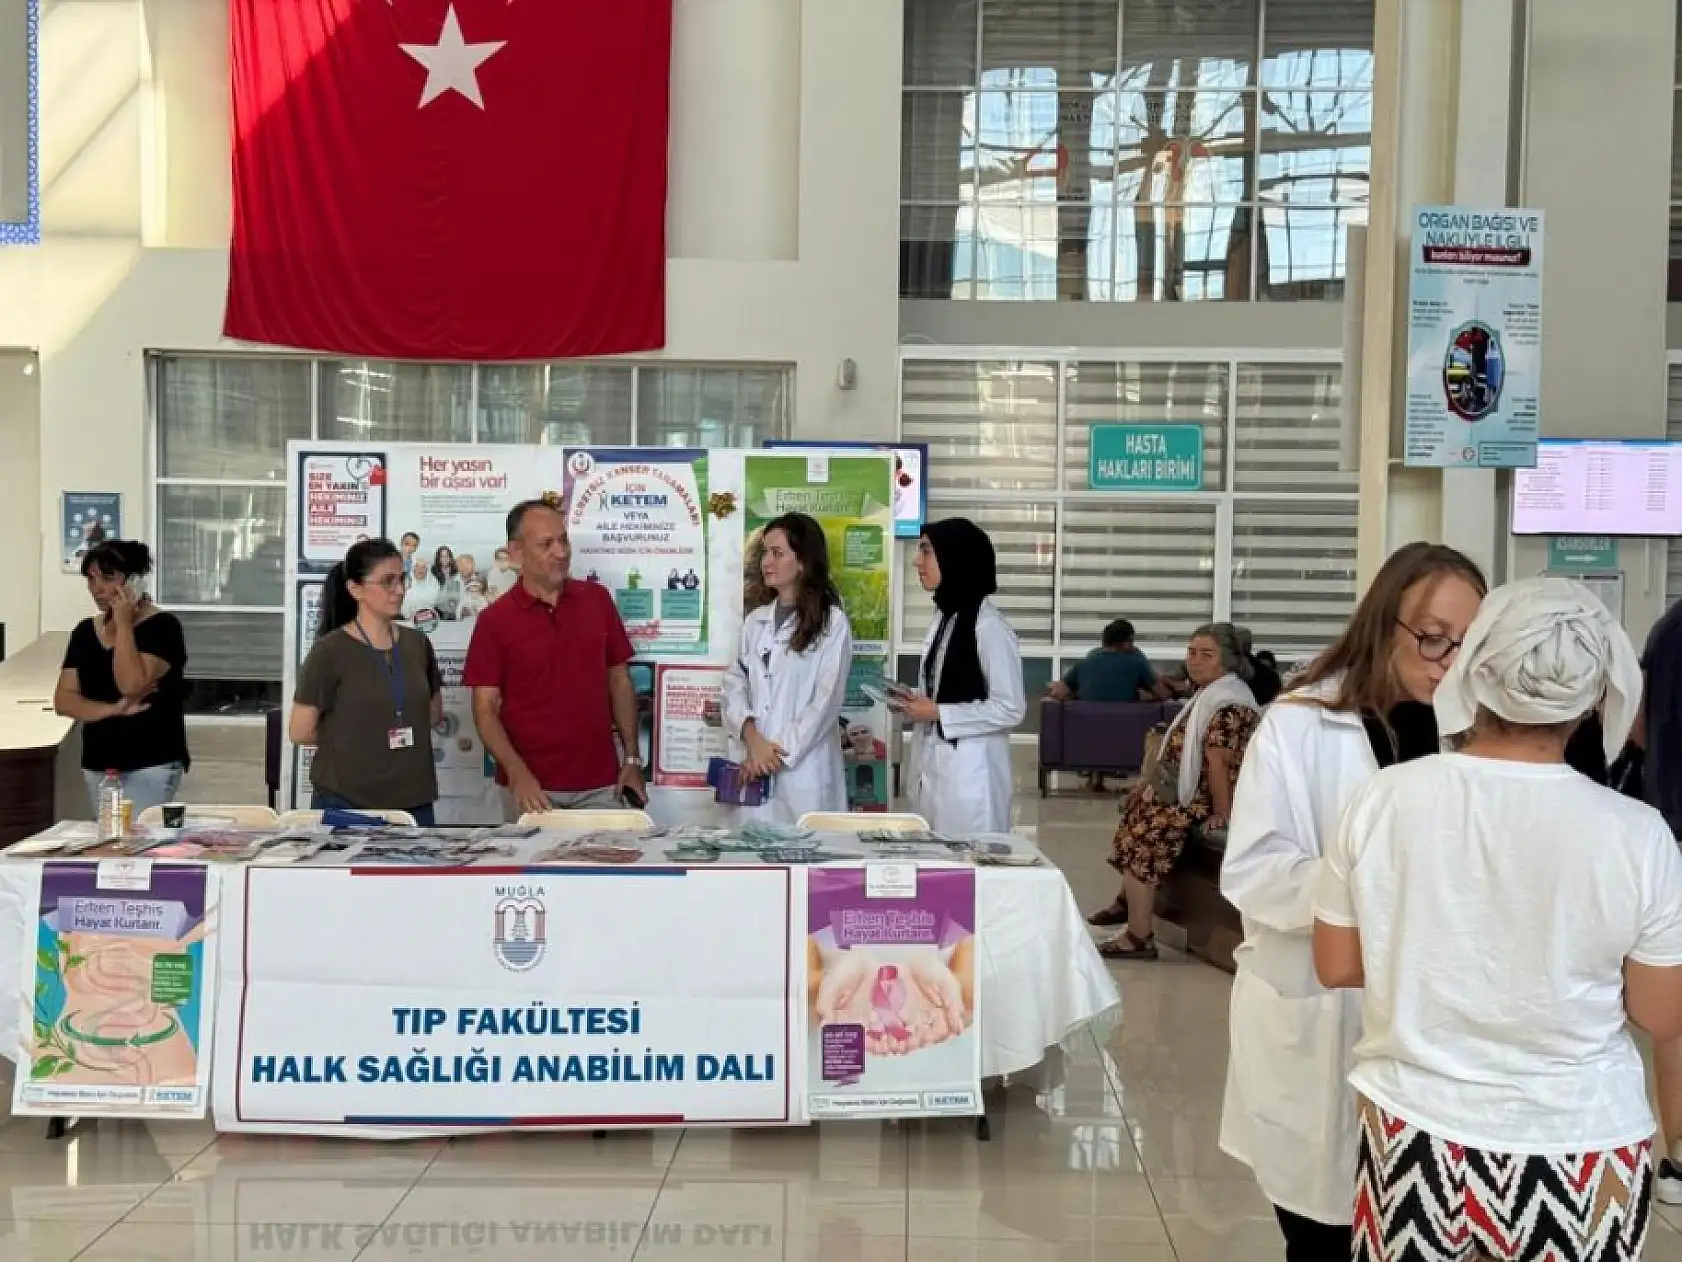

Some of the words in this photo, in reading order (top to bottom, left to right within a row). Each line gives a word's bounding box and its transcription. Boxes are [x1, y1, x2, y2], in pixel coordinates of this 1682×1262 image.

[1418, 212, 1469, 229] ORGAN
[1519, 216, 1539, 233] VE
[1125, 433, 1168, 455] HASTA
[419, 456, 449, 471] Her
[1098, 459, 1152, 479] HAKLARI
[1155, 454, 1195, 479] BİRİMİ
[419, 473, 440, 488] bir
[479, 473, 507, 489] var!
[610, 494, 668, 507] KETEM
[623, 511, 650, 520] VEYA
[494, 885, 545, 897] MUĞLA
[74, 916, 111, 930] Hayat
[391, 1007, 447, 1035] TIP
[457, 1000, 641, 1035] FAKÜLTESİ
[252, 1055, 348, 1083] HALK
[357, 1047, 501, 1083] SAĞLIĞI
[511, 1047, 685, 1083] ANABİLİM
[696, 1053, 775, 1082] DALI
